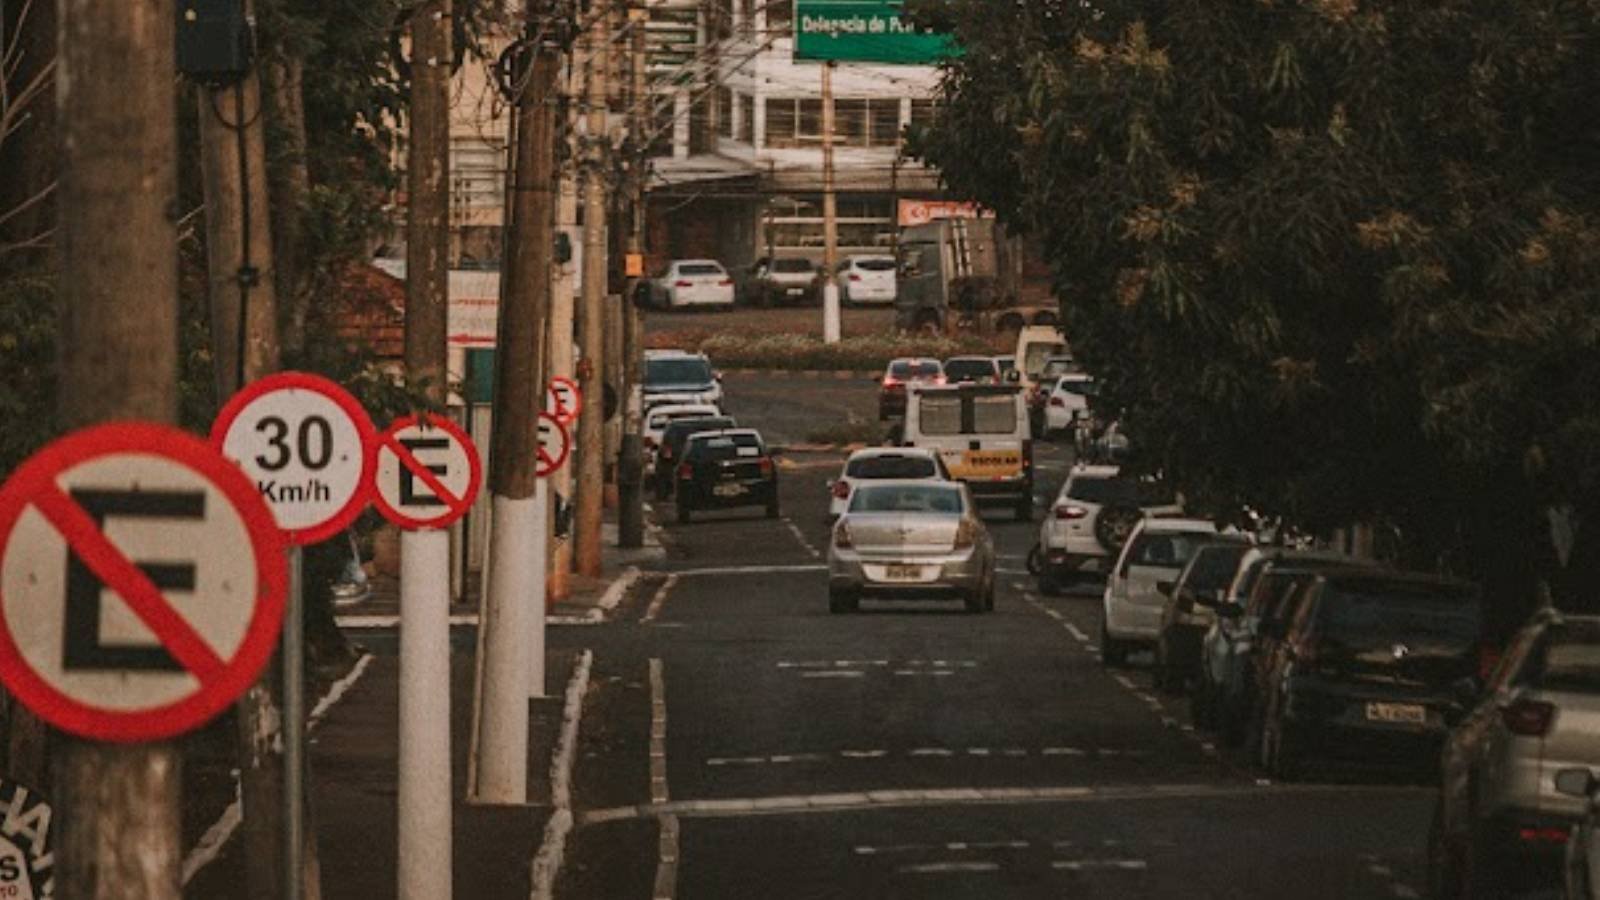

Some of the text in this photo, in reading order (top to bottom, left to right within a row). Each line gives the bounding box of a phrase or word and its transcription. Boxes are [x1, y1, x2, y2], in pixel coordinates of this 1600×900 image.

[802, 14, 867, 38] Delegacia
[868, 15, 885, 33] de
[554, 387, 569, 416] E
[255, 414, 334, 472] 30
[257, 479, 330, 502] Km/h
[398, 438, 449, 506] E
[61, 487, 206, 672] E
